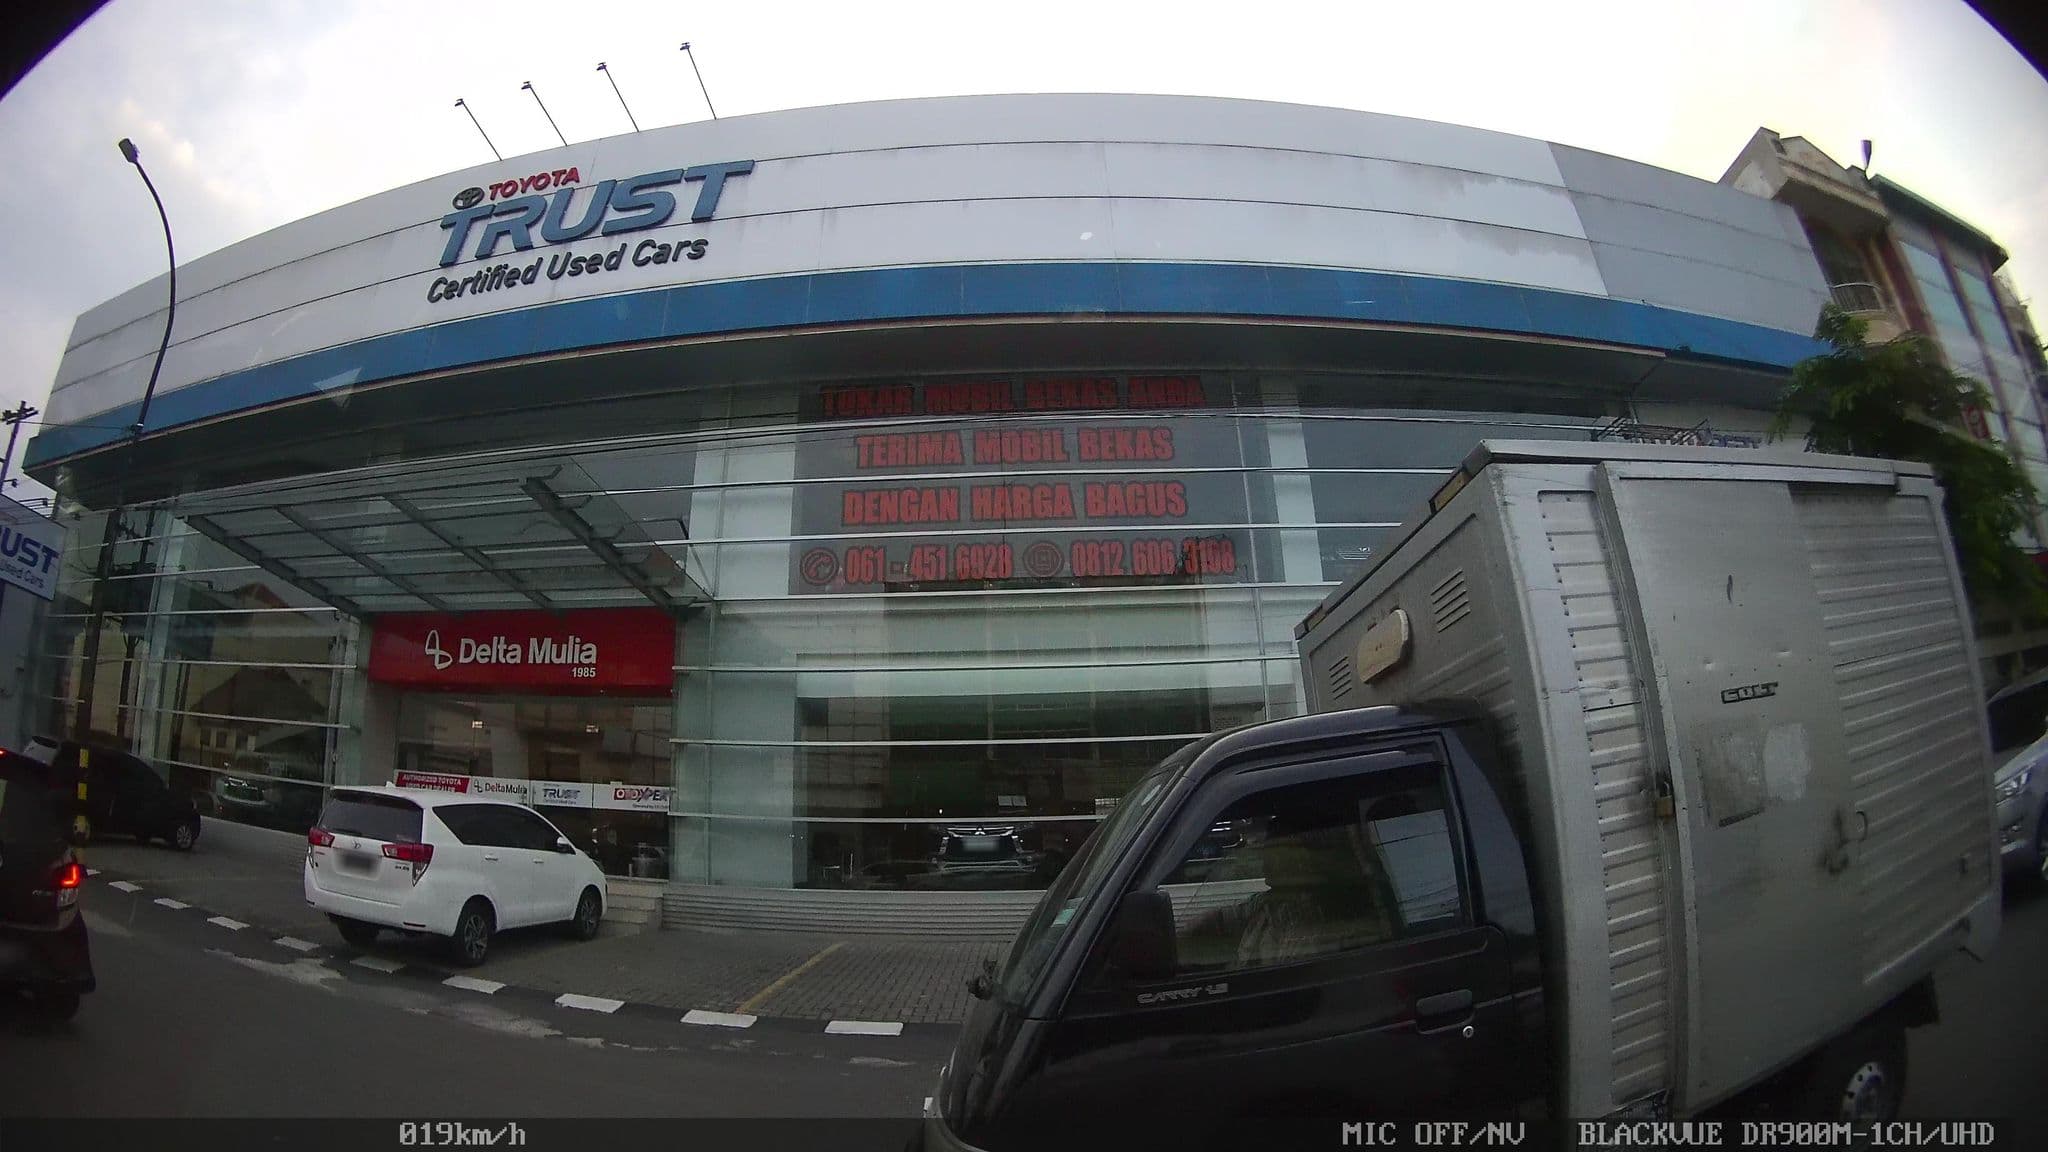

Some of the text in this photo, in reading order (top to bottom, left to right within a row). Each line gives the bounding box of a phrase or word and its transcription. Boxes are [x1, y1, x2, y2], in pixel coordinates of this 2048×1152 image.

[490, 167, 580, 200] TOYOTA
[439, 159, 755, 268] TRUST
[427, 238, 709, 303] Certified Used Cars
[857, 427, 1174, 468] TERIMA MOBIL BEKAS
[843, 483, 1187, 524] DENGAN HARGA BAGUS
[0, 527, 60, 574] UST
[845, 548, 886, 583] 061
[909, 547, 948, 581] 451
[1071, 542, 1125, 577] 0812
[459, 635, 598, 665] Delta Mulia
[572, 666, 597, 679] 1985
[1721, 681, 1779, 704] COLT
[543, 788, 580, 800] TRUST
[1137, 986, 1202, 1004] CARRY
